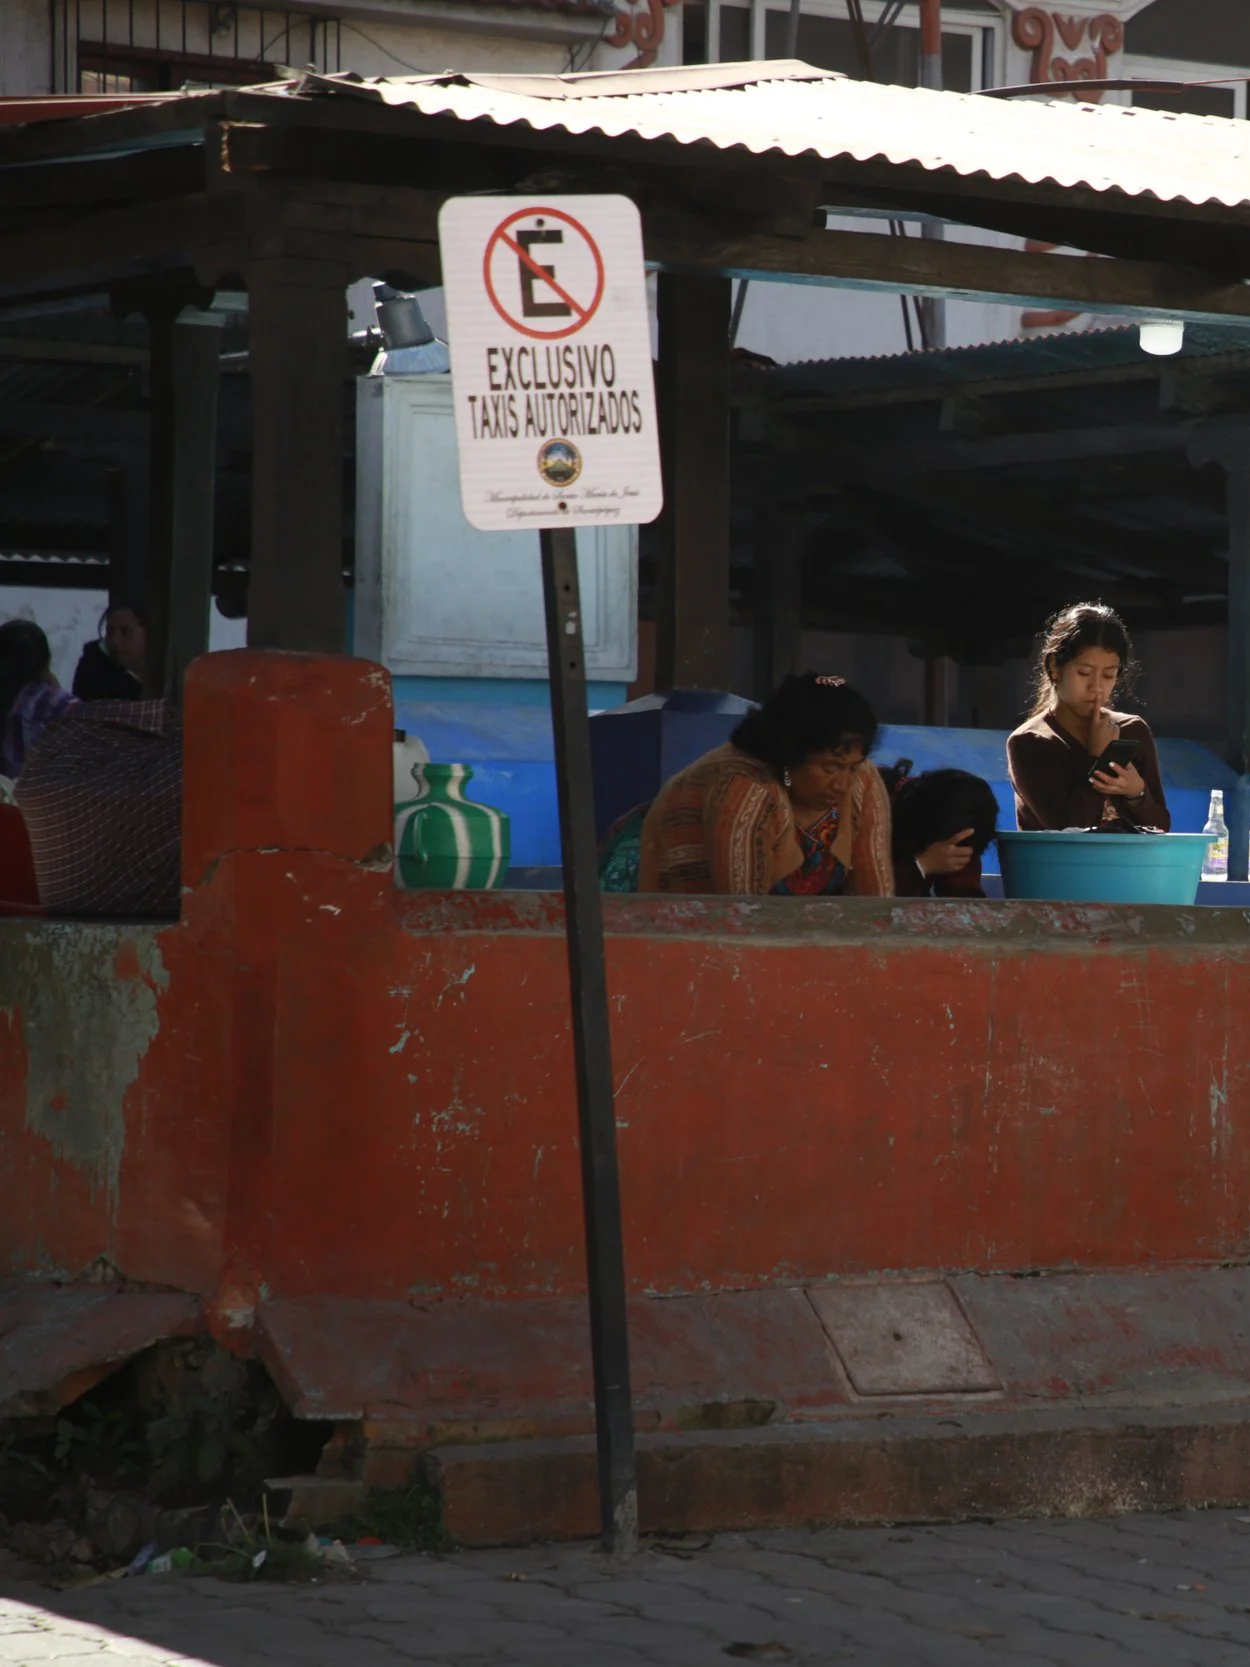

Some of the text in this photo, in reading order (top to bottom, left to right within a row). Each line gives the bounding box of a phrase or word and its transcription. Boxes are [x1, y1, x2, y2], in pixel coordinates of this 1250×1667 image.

[516, 229, 572, 318] E
[486, 344, 616, 391] EXCLUSIVO
[467, 390, 642, 439] TAXIS AUTORIZADOS
